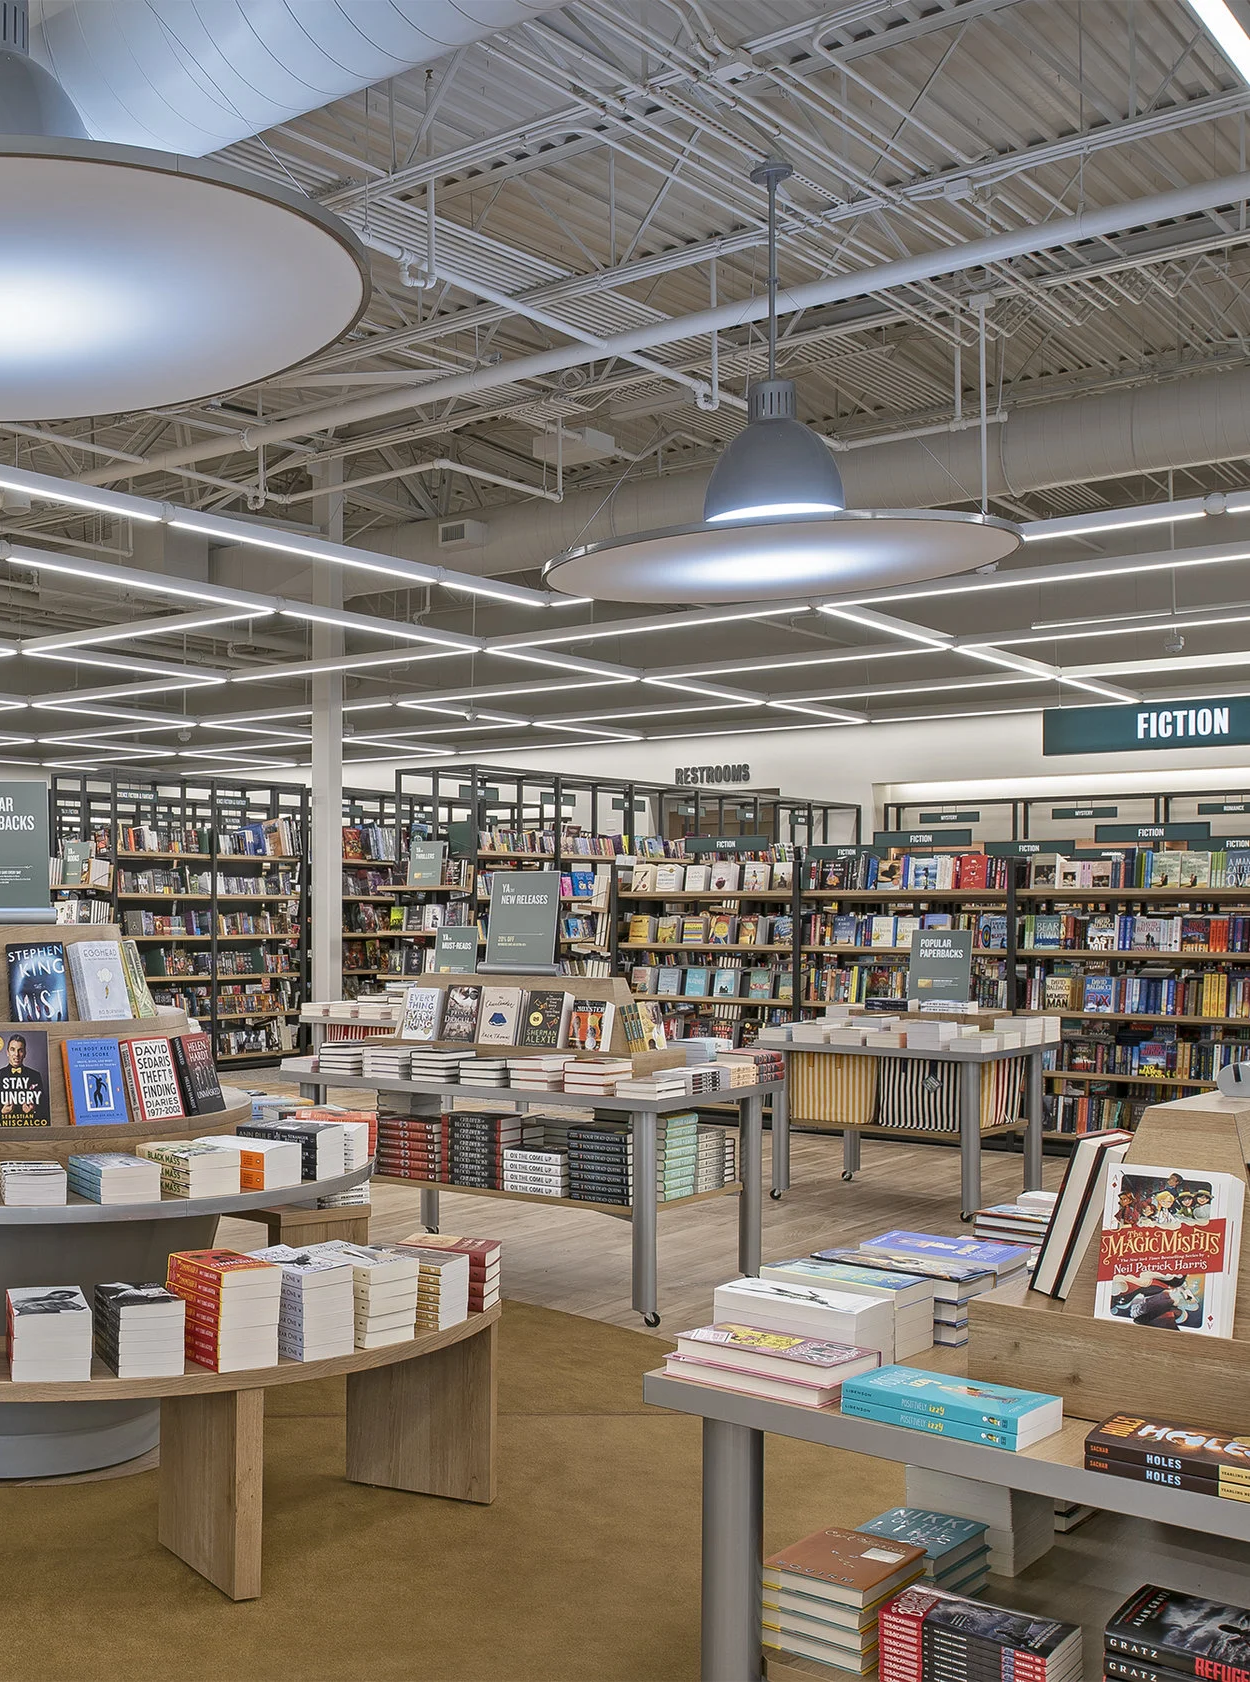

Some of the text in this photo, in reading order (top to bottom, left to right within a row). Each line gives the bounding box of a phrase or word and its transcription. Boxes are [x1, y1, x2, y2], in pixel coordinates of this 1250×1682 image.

[1137, 707, 1230, 739] FICTION
[675, 763, 750, 785] RESTROOMS
[1138, 828, 1165, 837] FICTION
[716, 840, 736, 848] FICTION
[910, 835, 932, 843] FICTION
[1226, 840, 1250, 848] FICTION
[502, 883, 510, 893] YA
[501, 895, 549, 905] NEW RELEASES
[1037, 923, 1059, 931] BEAR
[1036, 931, 1060, 939] TOWN
[1087, 936, 1107, 944] LAST
[442, 941, 472, 950] MUST-READS
[920, 938, 952, 948] POPULAR
[1183, 944, 1208, 952] FALLEN
[7, 945, 63, 962] STEPHEN
[920, 949, 963, 959] PAPERBACKS
[19, 959, 65, 978] KING
[409, 993, 435, 1002] EVERY
[408, 1001, 434, 1010] THING
[1046, 999, 1068, 1008] MAN
[406, 1010, 433, 1019] EVERY
[444, 1014, 476, 1023] DRACULA
[405, 1019, 433, 1029] THING
[526, 1029, 558, 1037] SHERMAN
[525, 1036, 556, 1044] ALEXIE
[135, 1044, 167, 1056] DAVID
[187, 1041, 206, 1052] HELEN
[189, 1051, 209, 1062] HARDT
[759, 1054, 771, 1063] DRY
[137, 1055, 170, 1070] SEDARIS
[763, 1064, 775, 1073] DRY
[140, 1069, 167, 1084] THEFT
[763, 1074, 775, 1082] DRY
[2, 1077, 29, 1089] STAY
[143, 1083, 177, 1098] FINDING
[197, 1088, 221, 1099] UNMASKED
[146, 1097, 179, 1109] DIARIES
[147, 1105, 181, 1117] 1977-2002
[254, 1132, 272, 1140] RULE
[147, 1150, 181, 1166] BLACK MASS
[165, 1168, 181, 1180] MASS
[164, 1182, 181, 1193] MASS
[1127, 1230, 1143, 1238] The
[1113, 1259, 1208, 1274] Neil Patrick Harris
[845, 1388, 945, 1416] LIBENSON POSITIVELY izzy
[1090, 1445, 1109, 1454] SACHAR
[1146, 1454, 1182, 1470] HOLES
[1221, 1471, 1244, 1479] YEARLING
[1089, 1460, 1243, 1495] SACHAR HOLES YEARLING
[891, 1509, 974, 1531] NIKKI
[891, 1519, 954, 1537] ON THE
[777, 1560, 854, 1583] SQUIRM
[1133, 1592, 1170, 1627] ALAN GRATZ
[1110, 1638, 1158, 1659] GRATZ
[1016, 1652, 1033, 1661] WARNER
[1109, 1662, 1158, 1682] GRATZ
